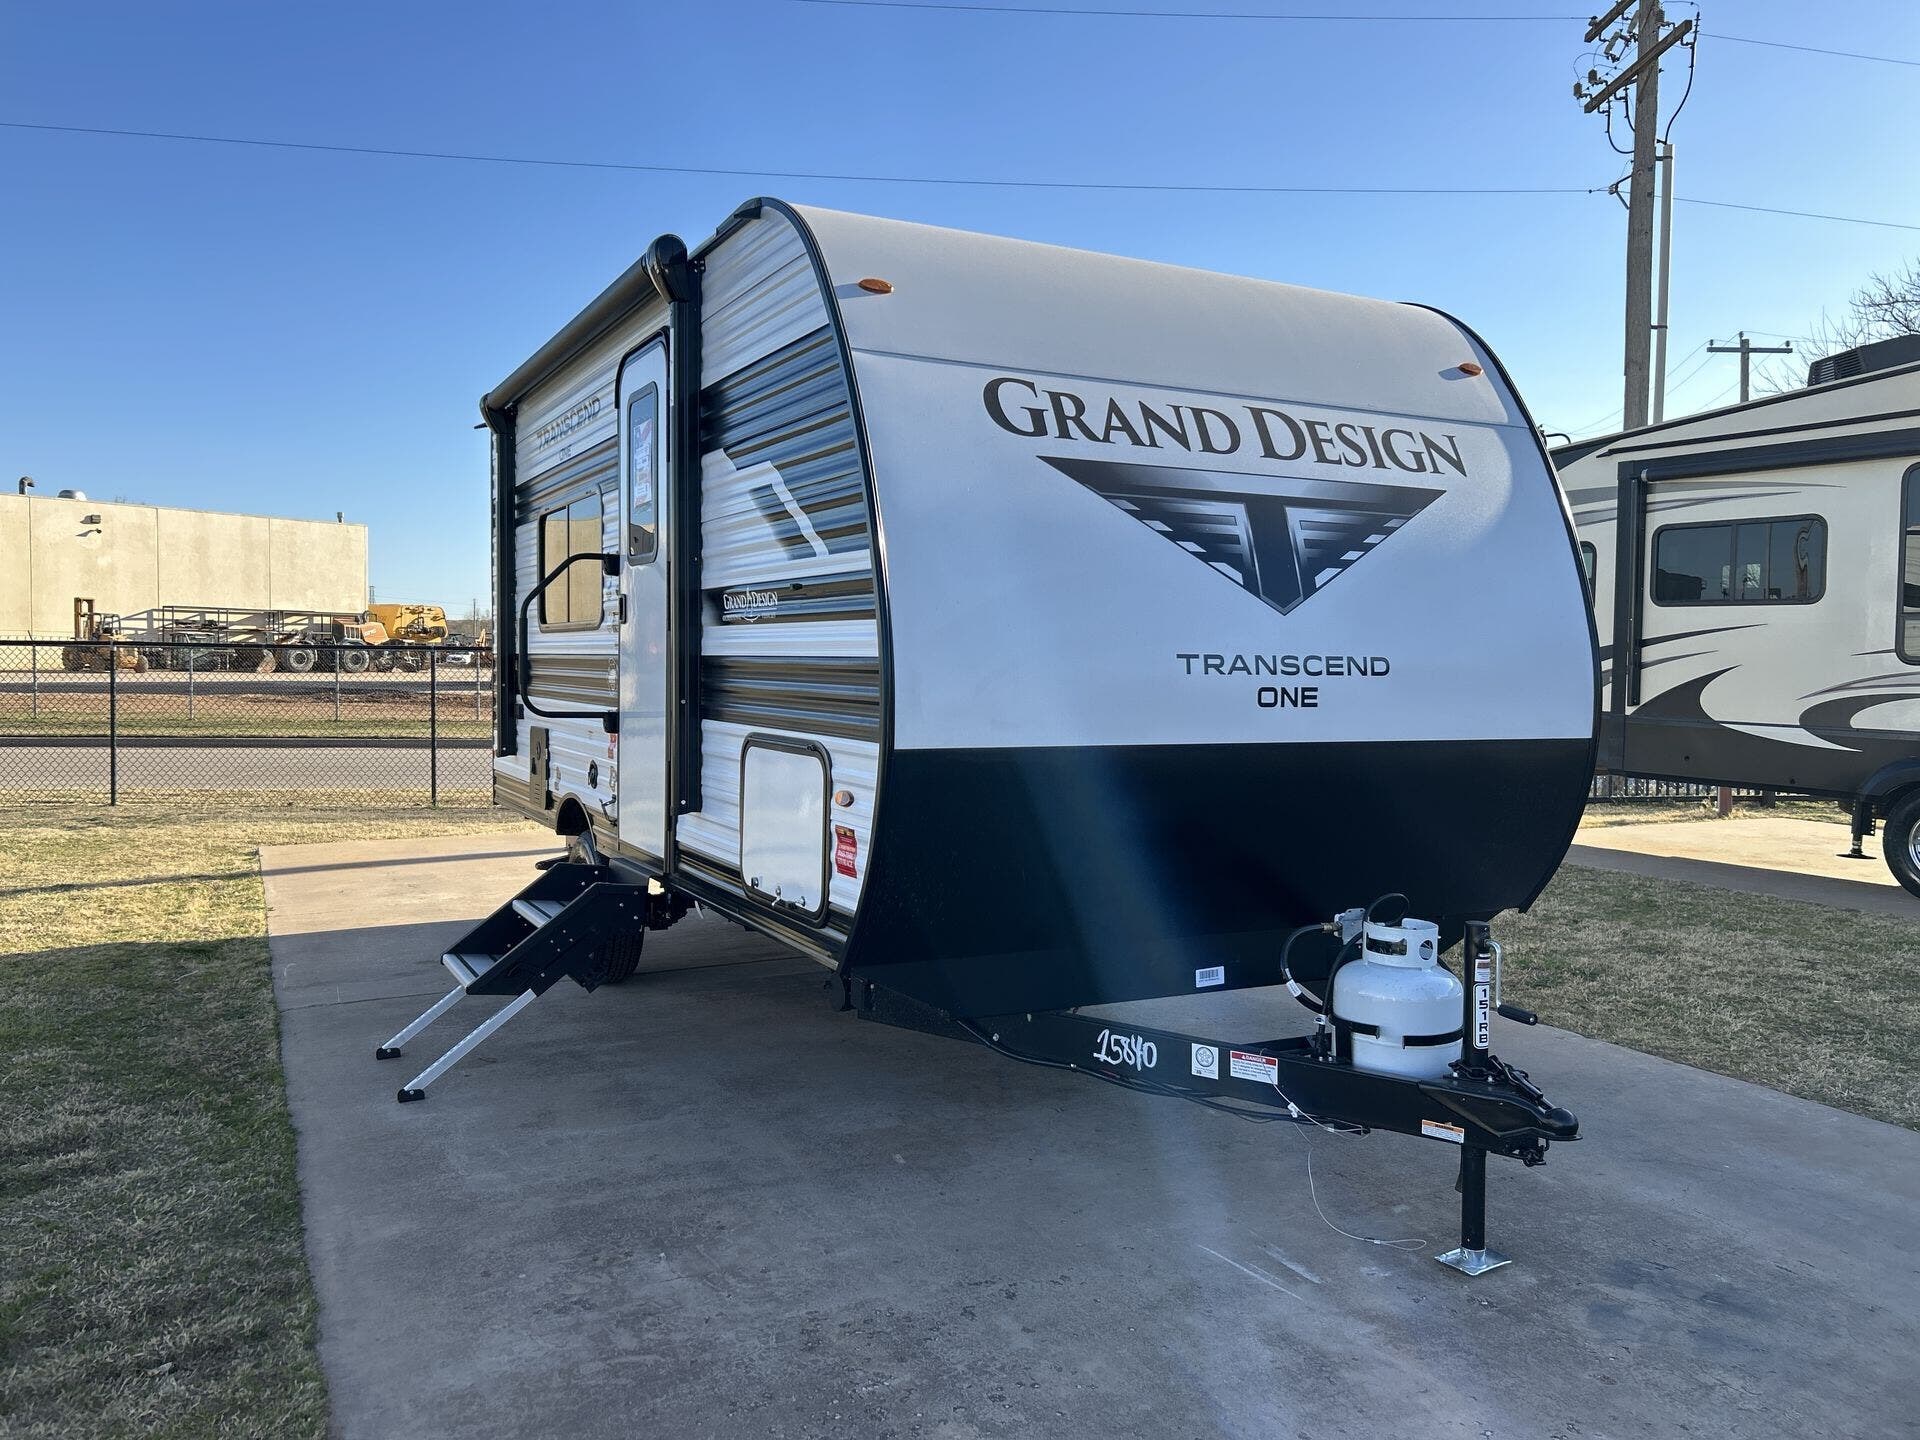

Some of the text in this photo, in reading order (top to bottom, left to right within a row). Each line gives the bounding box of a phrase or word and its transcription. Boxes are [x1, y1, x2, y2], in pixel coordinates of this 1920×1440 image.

[537, 396, 600, 450] TRANSCEND
[983, 377, 1468, 478] GRAND DESIGN
[723, 591, 778, 610] GRAND DESIGN
[1176, 653, 1391, 677] TRANSCEND
[1256, 686, 1319, 708] ONE
[1478, 988, 1489, 1044] 151RB
[1093, 1028, 1158, 1072] 15840
